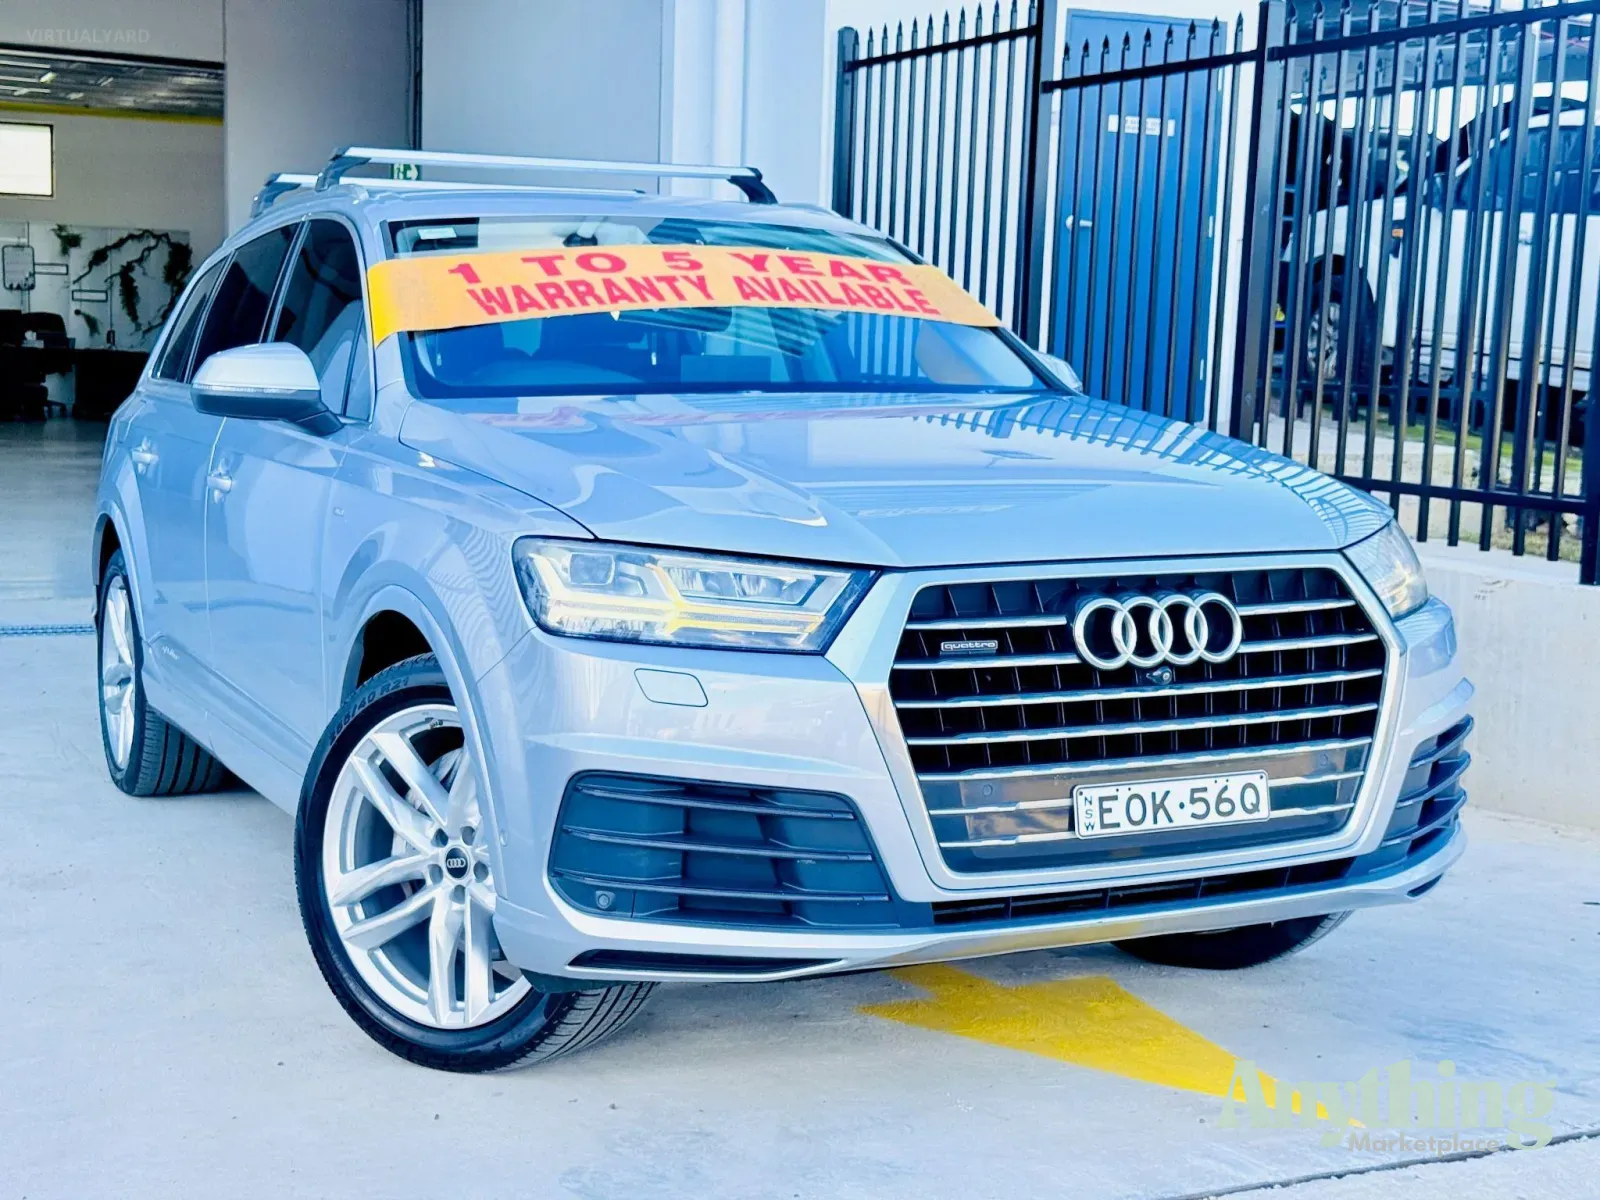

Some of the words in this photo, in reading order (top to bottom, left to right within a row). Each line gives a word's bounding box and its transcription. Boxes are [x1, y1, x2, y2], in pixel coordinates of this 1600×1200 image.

[448, 263, 481, 285] 1
[521, 252, 627, 277] TO
[661, 251, 703, 271] 5
[727, 252, 914, 286] YEAR
[466, 275, 716, 317] WARRANTY
[732, 275, 941, 316] AVAILABLE
[944, 641, 997, 651] quattro
